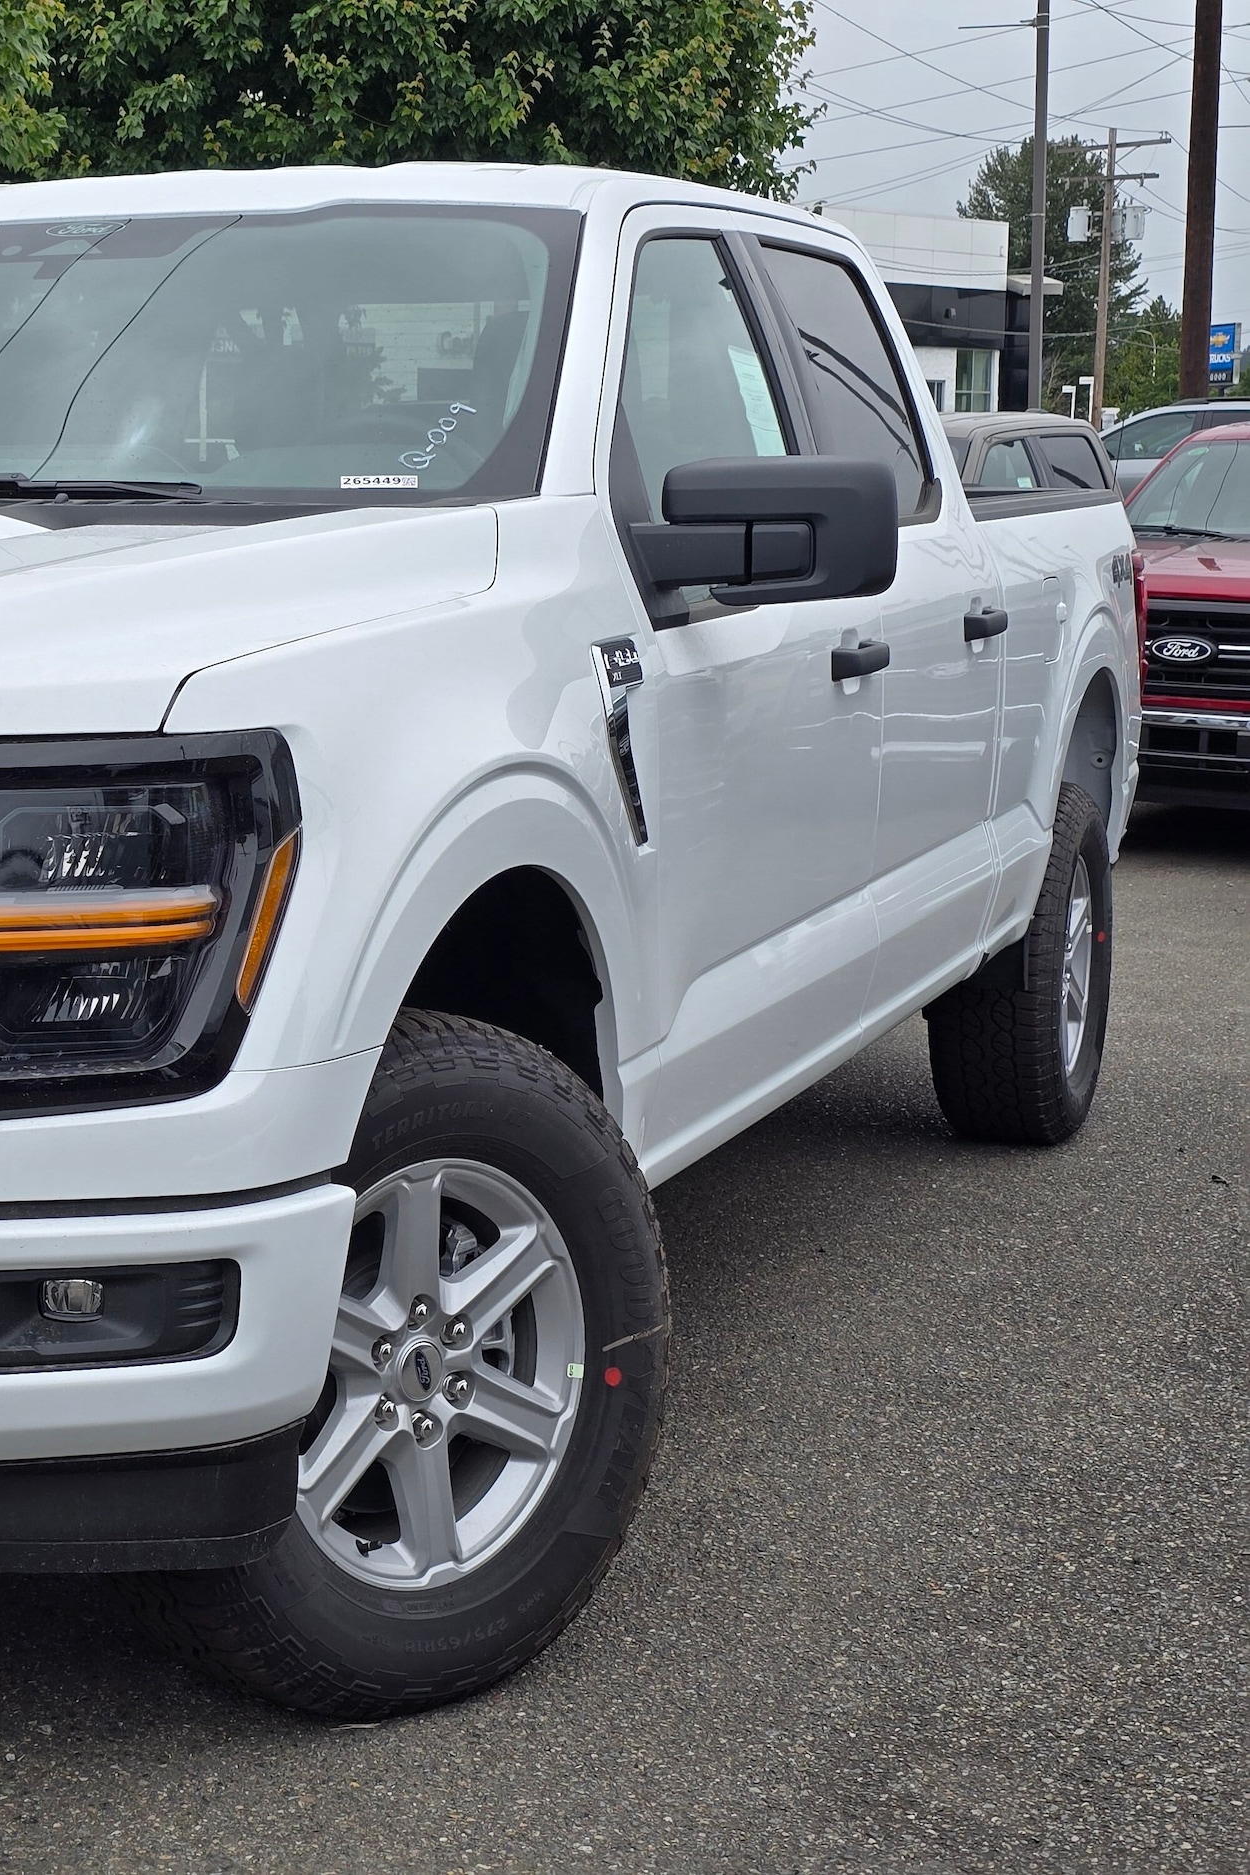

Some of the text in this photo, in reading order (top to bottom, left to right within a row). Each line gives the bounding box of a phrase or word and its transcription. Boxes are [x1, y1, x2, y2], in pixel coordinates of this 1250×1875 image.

[58, 223, 113, 235] Ford
[1209, 353, 1231, 364] RUCKS
[343, 477, 401, 485] 265449
[1162, 641, 1199, 658] Ford
